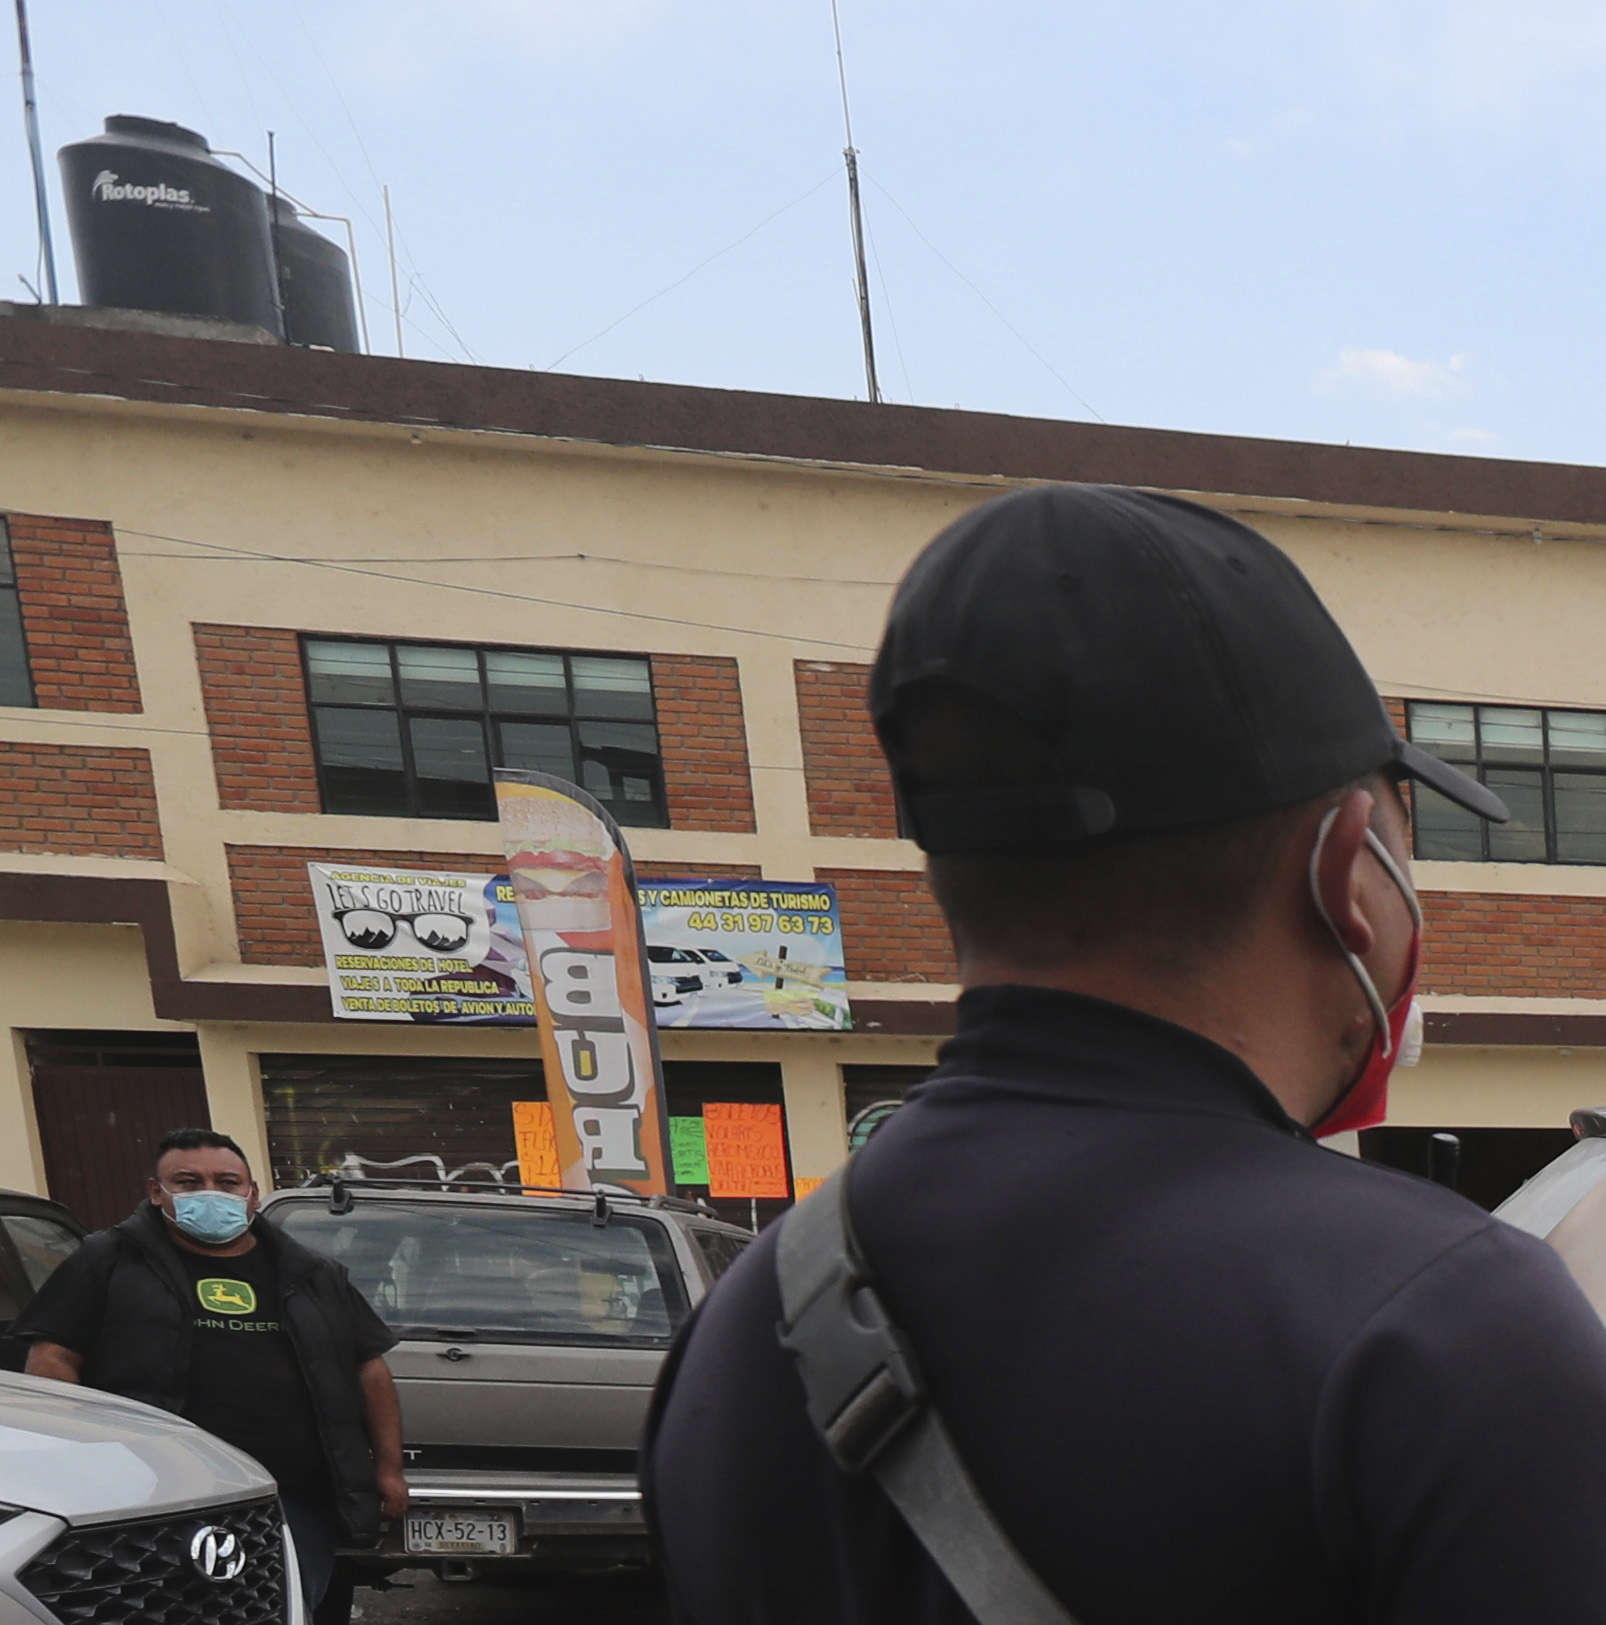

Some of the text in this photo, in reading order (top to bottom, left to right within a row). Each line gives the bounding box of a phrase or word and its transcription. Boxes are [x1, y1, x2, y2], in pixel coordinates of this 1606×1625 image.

[101, 183, 190, 205] Rotoplas
[331, 871, 467, 888] AGENCIA DE VIAJES
[377, 887, 402, 913] GO
[404, 888, 467, 915] TRAVEL
[660, 890, 749, 908] CAMIONETAS
[750, 892, 769, 909] DE
[769, 892, 831, 911] TURISMO
[687, 912, 835, 935] 44 31 97 63 73
[335, 955, 474, 974] RESERVACIONES DE HOTEL
[340, 975, 500, 995] VIAJES A TODA LA REPUBLICA
[341, 997, 378, 1011] VENTA
[378, 998, 392, 1012] DE
[392, 999, 440, 1014] BOLETOS
[442, 1000, 458, 1014] DE
[194, 1318, 280, 1332] HN DEER
[411, 1520, 508, 1541] HCX-52-13
